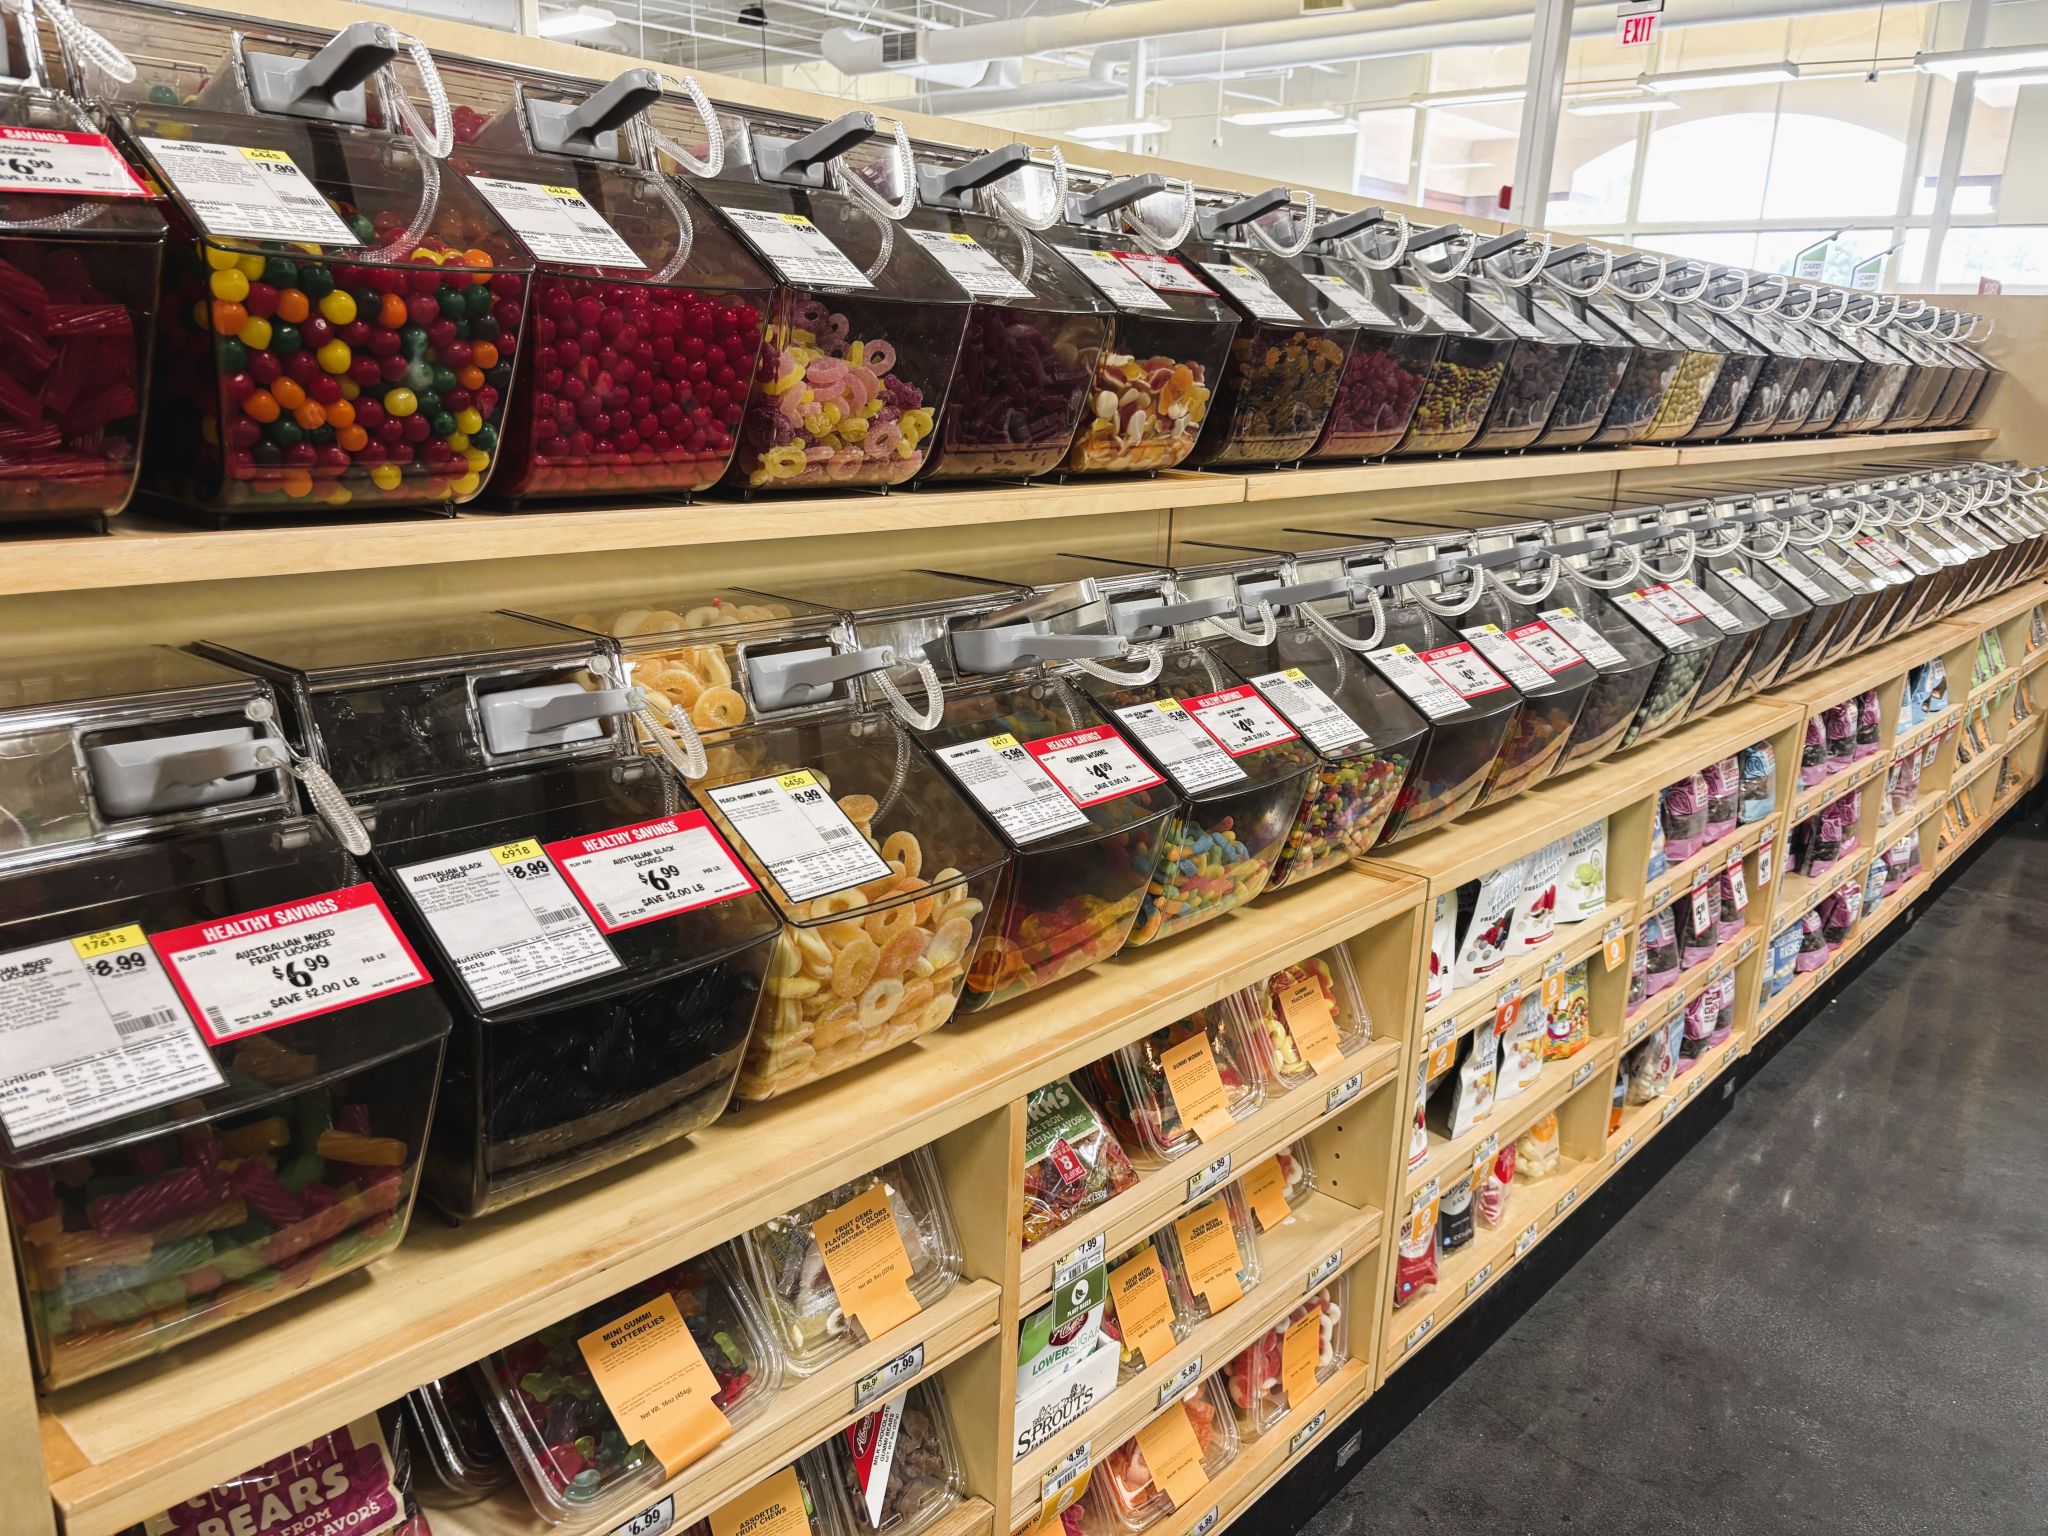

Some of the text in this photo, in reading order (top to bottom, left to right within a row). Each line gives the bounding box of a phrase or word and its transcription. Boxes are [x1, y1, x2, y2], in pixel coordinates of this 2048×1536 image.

[1623, 16, 1655, 44] EXIT
[3, 129, 69, 143] SAVINGS
[0, 174, 20, 182] AVE
[256, 163, 297, 174] $7.99
[1197, 695, 1220, 708] HEALTHY
[1046, 731, 1102, 751] HEALTHY SAVINGS
[1001, 748, 1024, 761] $5.99
[1066, 748, 1108, 764] GUMMI WORMS
[784, 777, 805, 788] 6450
[718, 795, 737, 804] PEACH
[791, 788, 822, 804] $6.99
[581, 820, 679, 853] HEALTHY SAVINGS
[502, 846, 530, 860] 6918
[612, 845, 676, 865] AUSTRALIAN BLACK
[634, 855, 665, 868] LICORICE
[413, 861, 484, 883] AUSTRALIAN BLACK
[435, 871, 469, 884] LICORICE
[506, 859, 550, 880] $8.99
[641, 883, 706, 907] SAVE $2.00 LB
[202, 898, 339, 943] HEALTHY SAVINGS
[83, 935, 127, 951] 17613
[235, 928, 336, 960] AUSTRALIAN MIXED
[249, 938, 332, 967] FRUIT LICORICE
[21, 957, 54, 970] MIXED
[87, 951, 146, 976] $8.99
[361, 955, 379, 965] PER
[454, 949, 497, 966] Nutrition
[458, 961, 486, 972] Facts
[499, 968, 511, 976] 100
[270, 976, 361, 1009] SAVE $2.00 LB
[46, 1094, 62, 1104] 100
[1040, 1113, 1065, 1130] FROM
[1054, 1113, 1087, 1135] FLAVORS
[1063, 1166, 1084, 1181] FLAVORS
[824, 1228, 855, 1249] FLAVORS
[861, 1207, 888, 1227] COLORS
[834, 1208, 874, 1236] FRUIT GEMS
[1205, 1217, 1220, 1228] NEON
[824, 1241, 842, 1256] FROM
[840, 1229, 867, 1248] NATURAL
[866, 1212, 892, 1232] SOURCES
[1137, 1265, 1152, 1278] NEON
[1066, 1298, 1092, 1318] PLANT-BASED
[602, 1311, 653, 1343] MINI GUMMI
[610, 1314, 666, 1349] BUTTERFLIES
[1031, 1326, 1101, 1377] LOWER SUGAR
[890, 1355, 915, 1376] $7.99
[639, 1386, 694, 1421] Net Wt. 16oz (454g)
[1015, 1386, 1095, 1458] SPROUTS
[873, 1404, 891, 1466] MILK CHOCOLATE
[879, 1412, 895, 1462] GUMMI BEARS
[1031, 1425, 1062, 1451] FARMERS
[1066, 1445, 1085, 1462] $4.99
[196, 1461, 351, 1536] BEARS
[280, 1507, 333, 1536] FROM
[628, 1508, 661, 1535] $6.99
[735, 1506, 788, 1536] FRUIT CHEWS
[739, 1503, 780, 1530] ASSORTED
